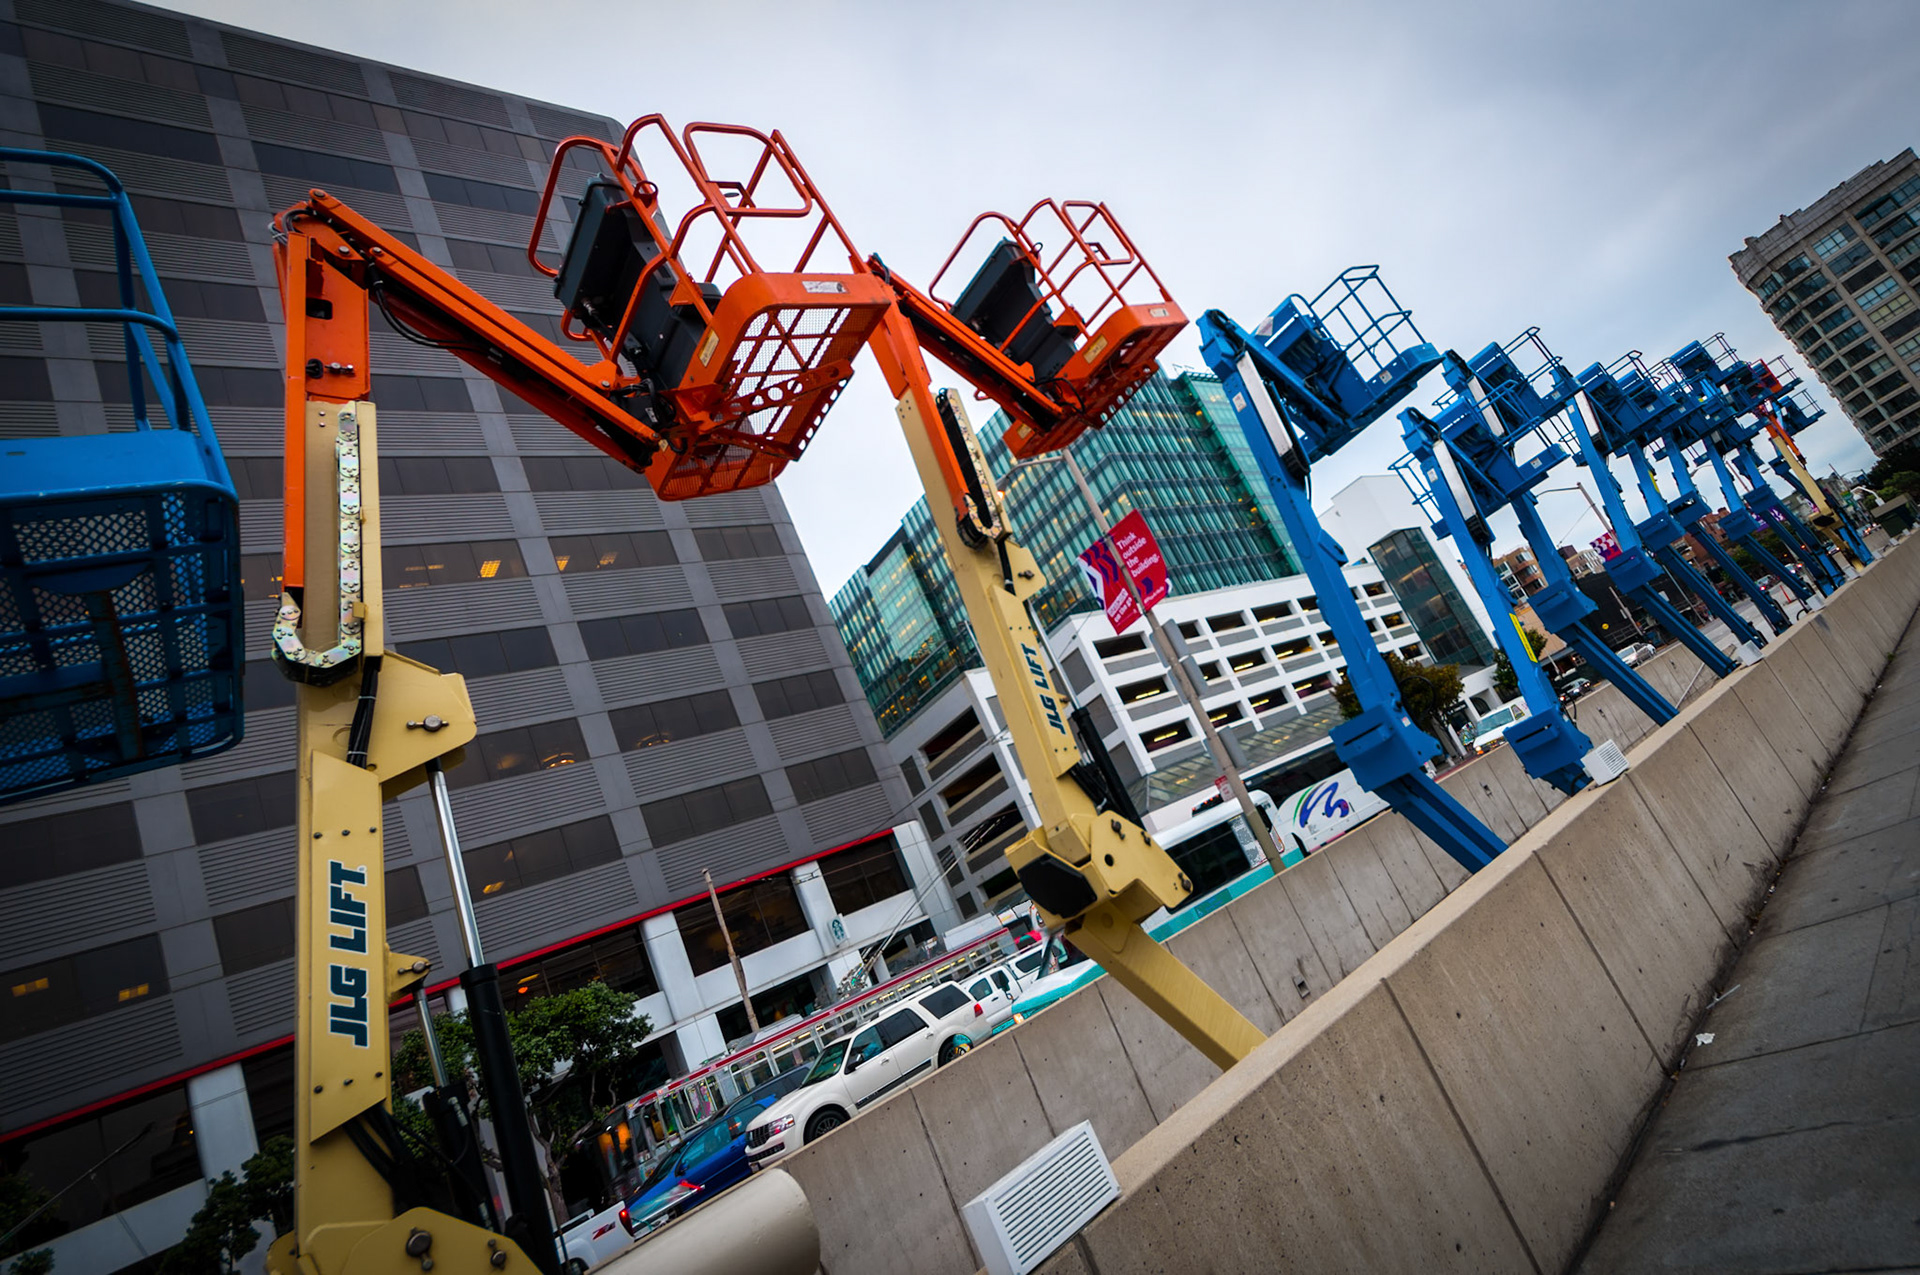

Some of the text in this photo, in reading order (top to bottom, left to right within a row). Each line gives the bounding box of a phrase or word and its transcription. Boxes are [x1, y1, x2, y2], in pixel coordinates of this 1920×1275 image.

[1116, 532, 1137, 550] Think
[1122, 537, 1147, 559] outside
[1126, 556, 1139, 569] the
[1131, 553, 1160, 578] building.
[1020, 643, 1067, 735] JLG LIFT
[329, 860, 369, 1048] JLG LIFT
